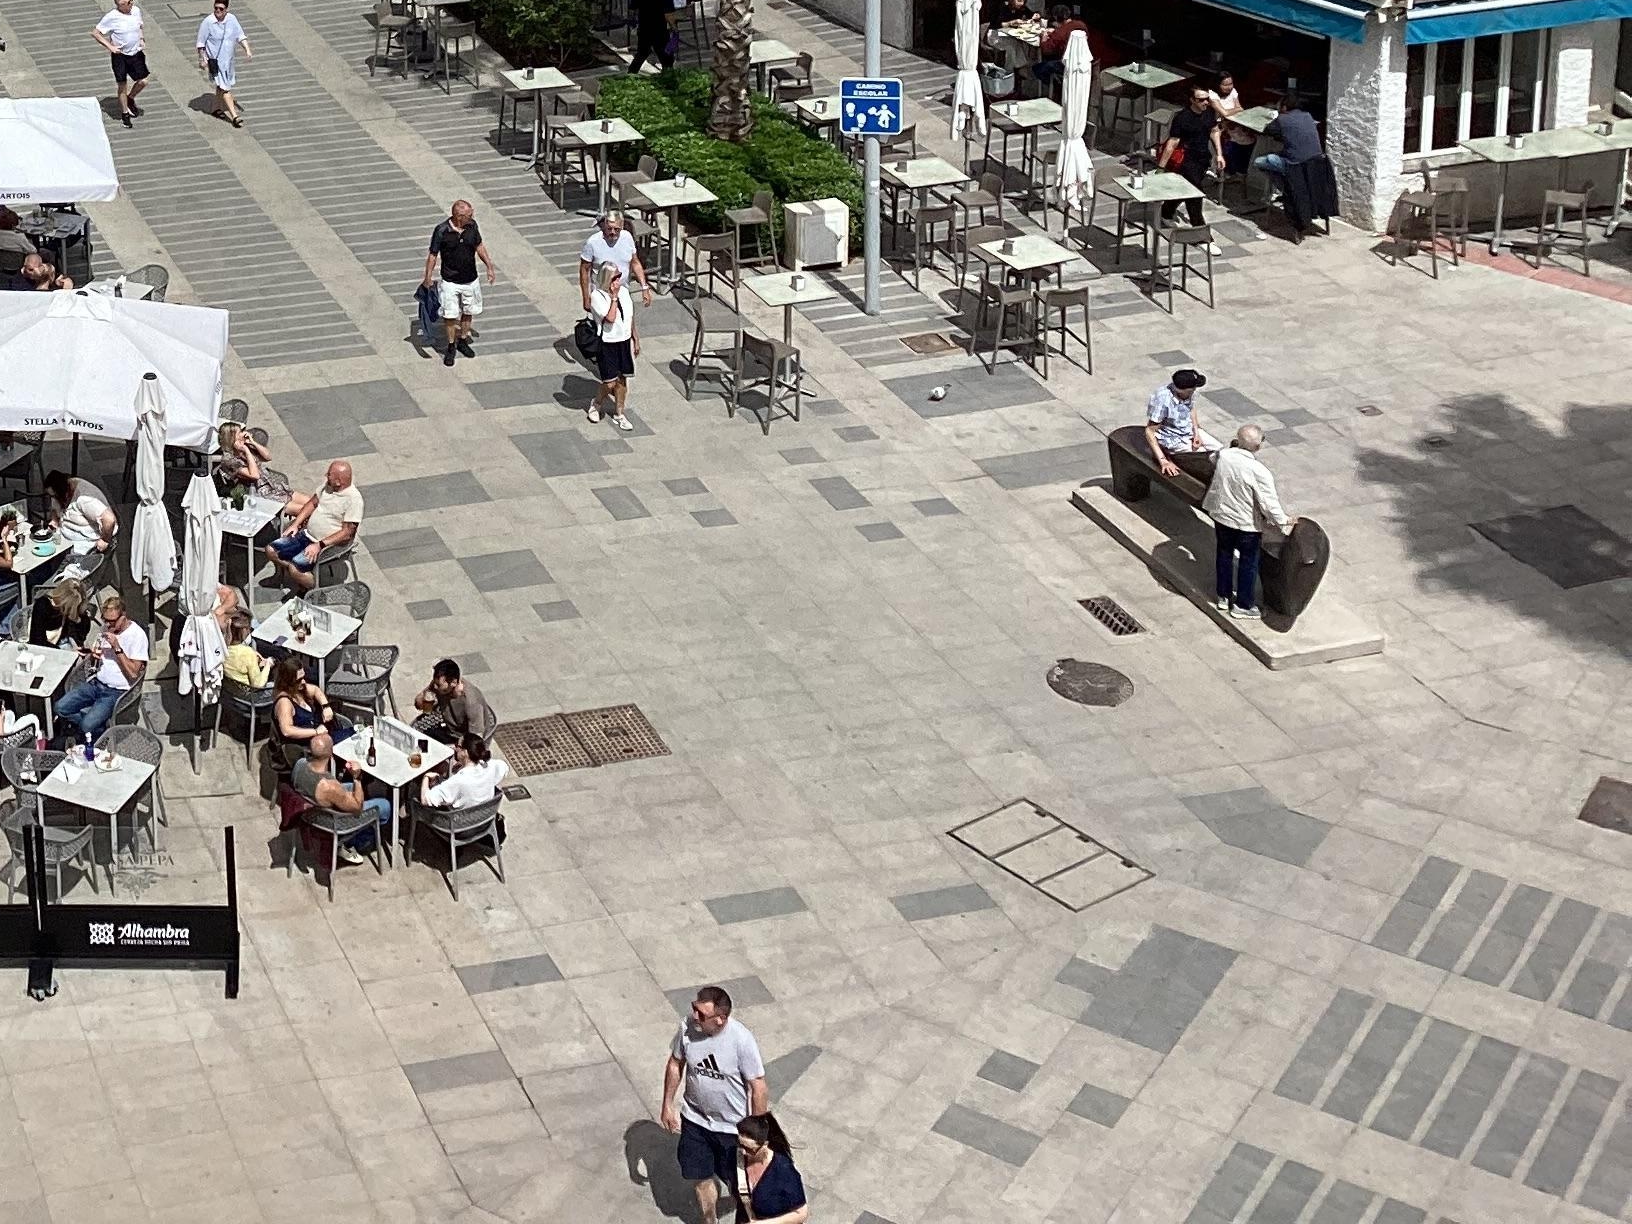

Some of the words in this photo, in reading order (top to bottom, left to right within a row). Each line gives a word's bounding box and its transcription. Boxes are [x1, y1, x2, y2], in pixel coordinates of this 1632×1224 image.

[0, 192, 31, 200] ARTOIS
[24, 417, 58, 426] STELLA
[68, 418, 104, 431] ARTOIS
[117, 923, 190, 939] Alhambra
